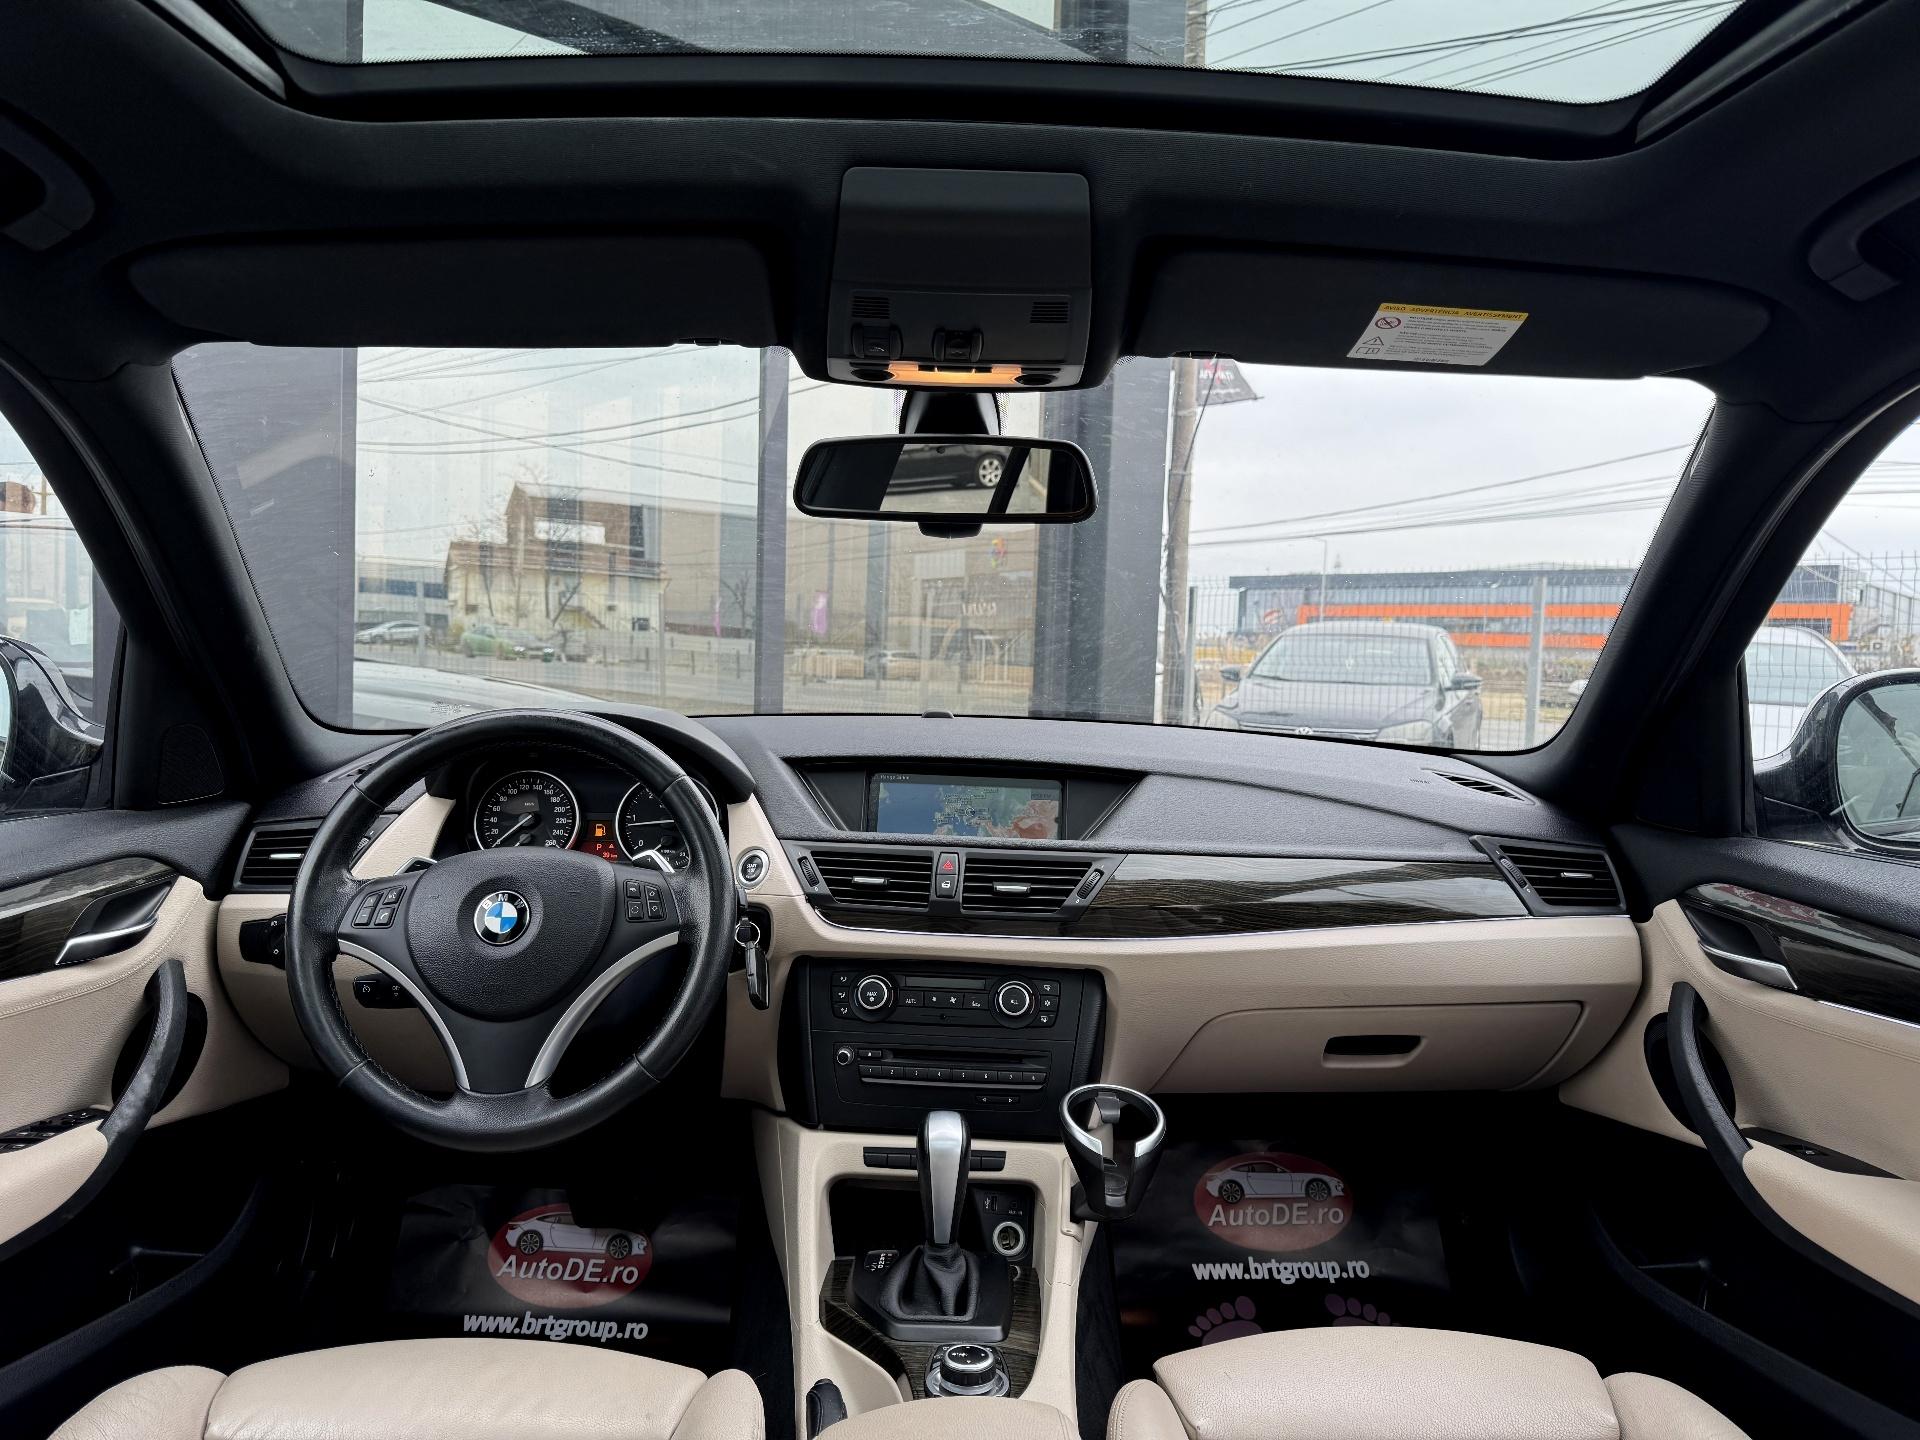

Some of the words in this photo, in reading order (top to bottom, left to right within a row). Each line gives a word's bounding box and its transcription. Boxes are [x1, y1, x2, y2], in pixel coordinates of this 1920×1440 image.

[1207, 1203, 1344, 1227] AutoDE.ro
[496, 1254, 639, 1285] AutoDE.ro
[1192, 1257, 1370, 1285] www.brtgroup.ro
[463, 1311, 649, 1342] www.brtgroup.ro
